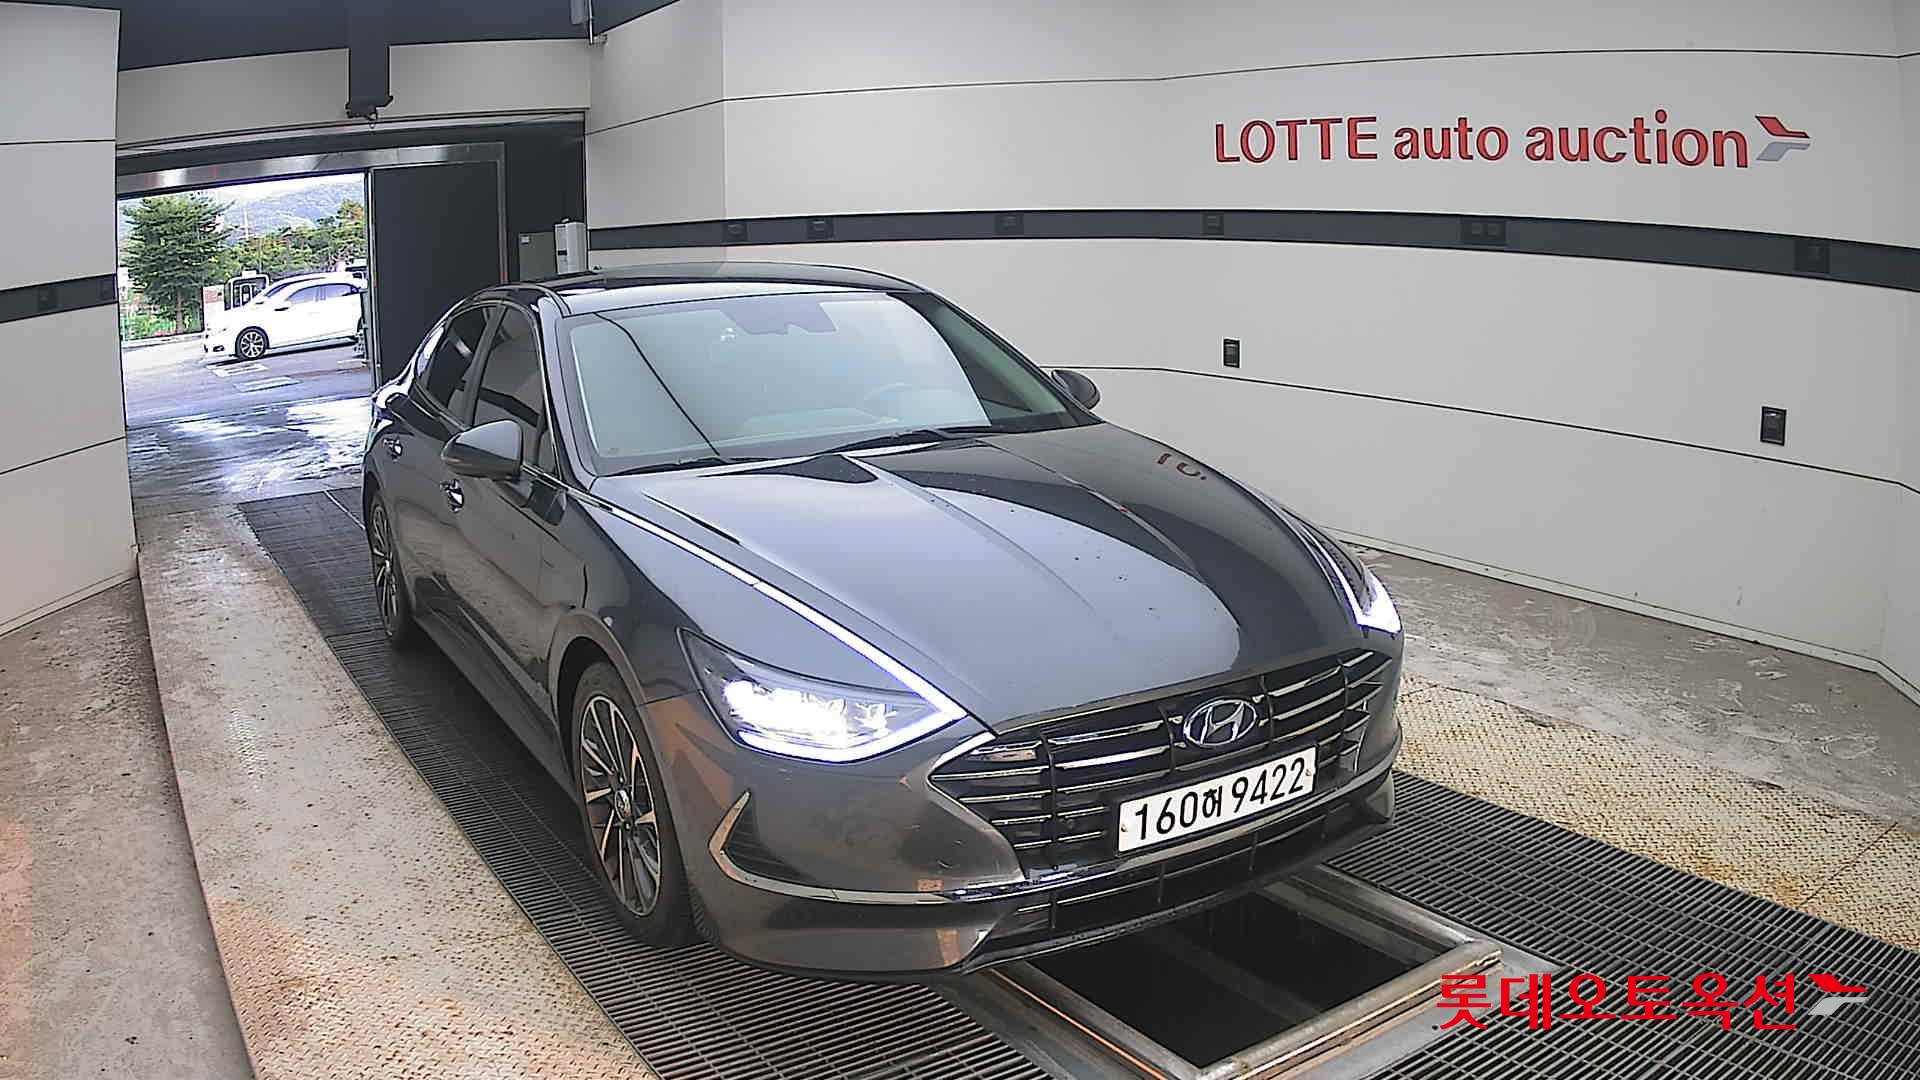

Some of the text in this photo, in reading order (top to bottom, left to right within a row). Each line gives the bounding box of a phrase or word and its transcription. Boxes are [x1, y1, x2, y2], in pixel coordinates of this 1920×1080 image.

[1215, 109, 1748, 168] LOTTE auto auction
[1231, 757, 1305, 814] 9422
